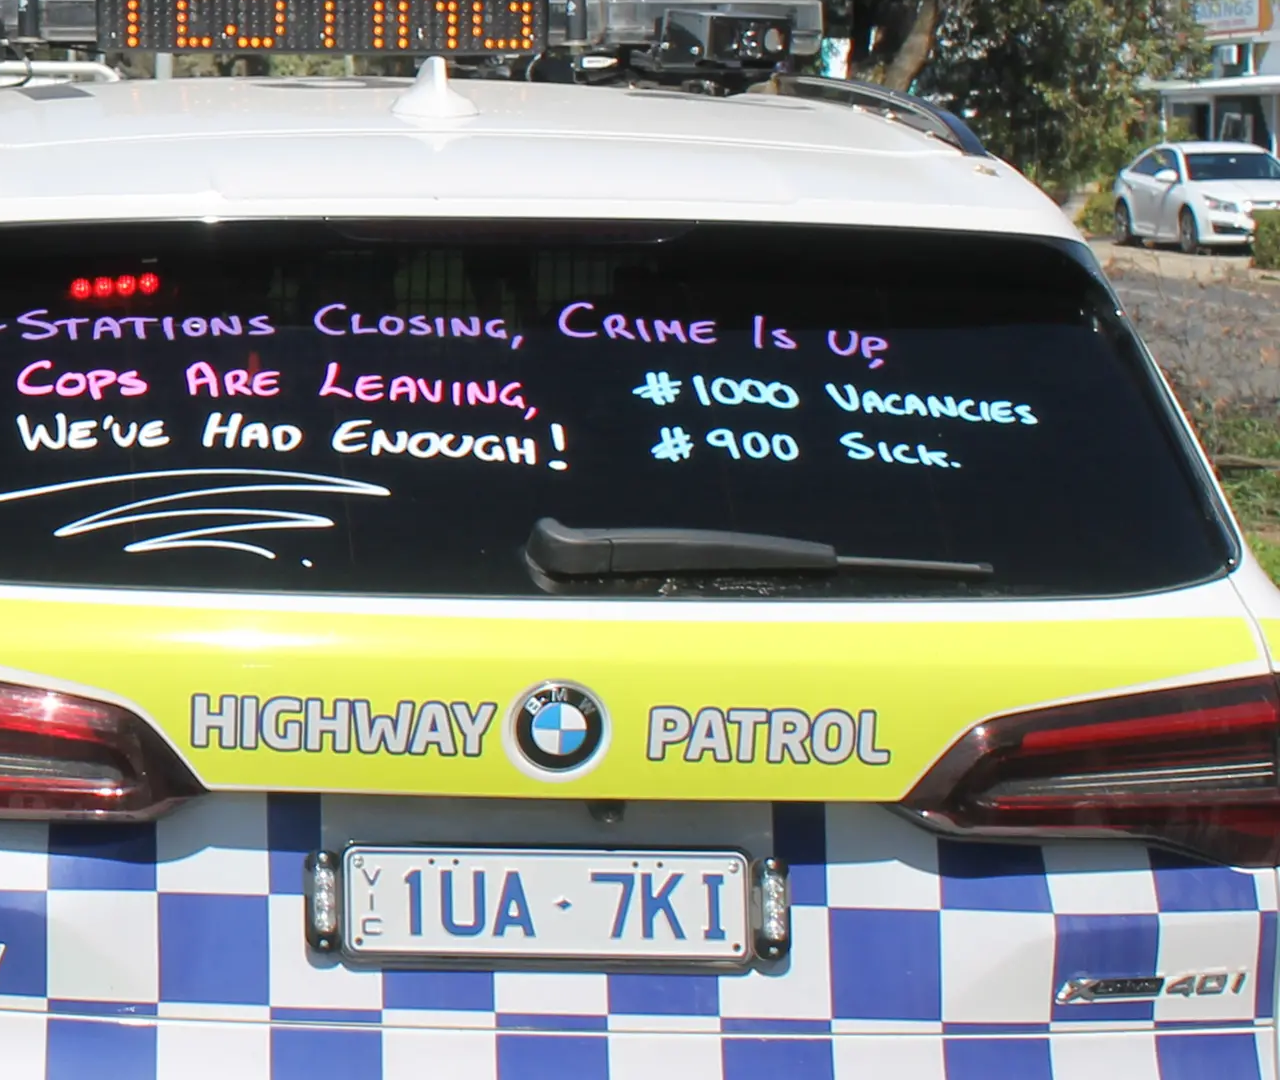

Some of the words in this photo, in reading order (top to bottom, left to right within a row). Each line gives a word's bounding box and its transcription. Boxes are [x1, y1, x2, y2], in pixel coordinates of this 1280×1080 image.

[17, 309, 275, 340] STATIONS
[558, 302, 717, 344] CRIME
[17, 360, 148, 400] COPS
[185, 361, 280, 397] ARE
[318, 361, 538, 421] LEAVING,
[825, 383, 1039, 425] VACANCIES
[16, 413, 170, 452] WE'VE
[201, 412, 302, 452] HAD
[524, 687, 596, 715] BMW
[191, 694, 498, 757] HIGHWAY
[646, 705, 891, 765] PATROL
